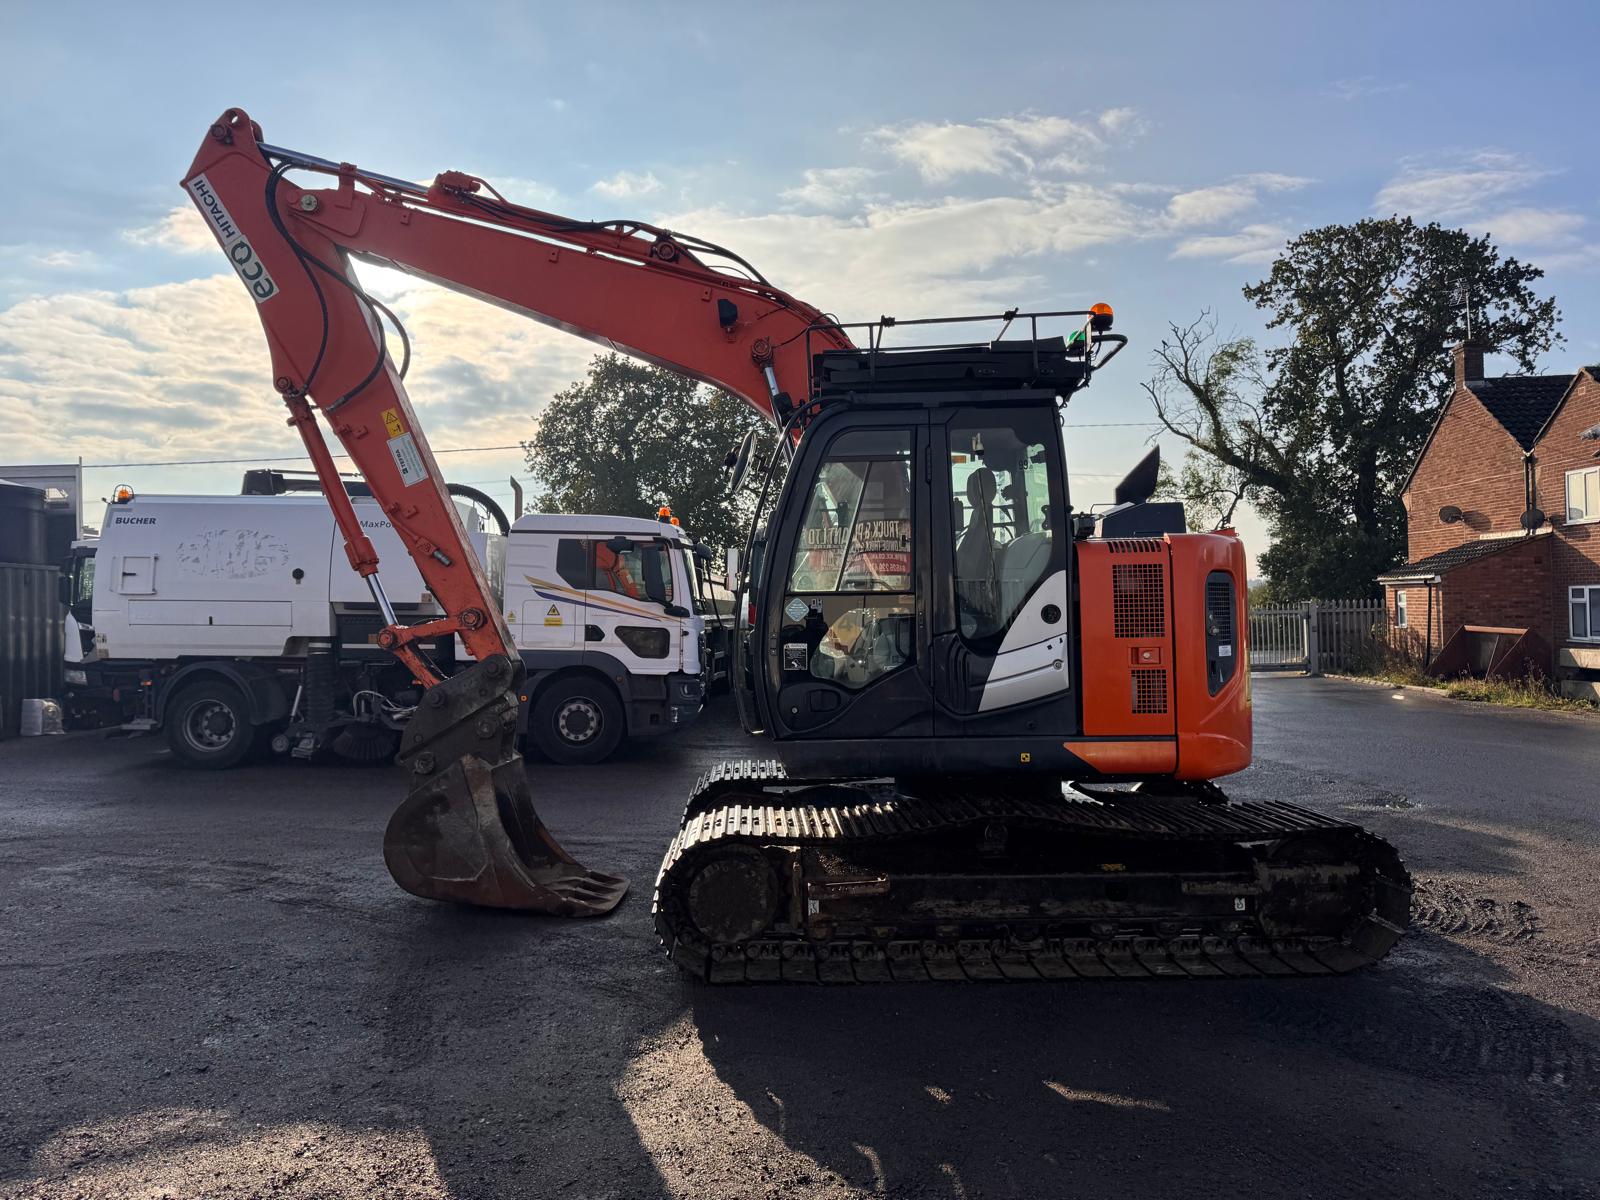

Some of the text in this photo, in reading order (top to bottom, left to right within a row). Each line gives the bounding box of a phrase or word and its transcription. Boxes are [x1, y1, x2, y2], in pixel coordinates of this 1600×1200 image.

[194, 180, 235, 238] HITACHI
[115, 517, 157, 525] BUCHER
[360, 520, 391, 528] MaxPo
